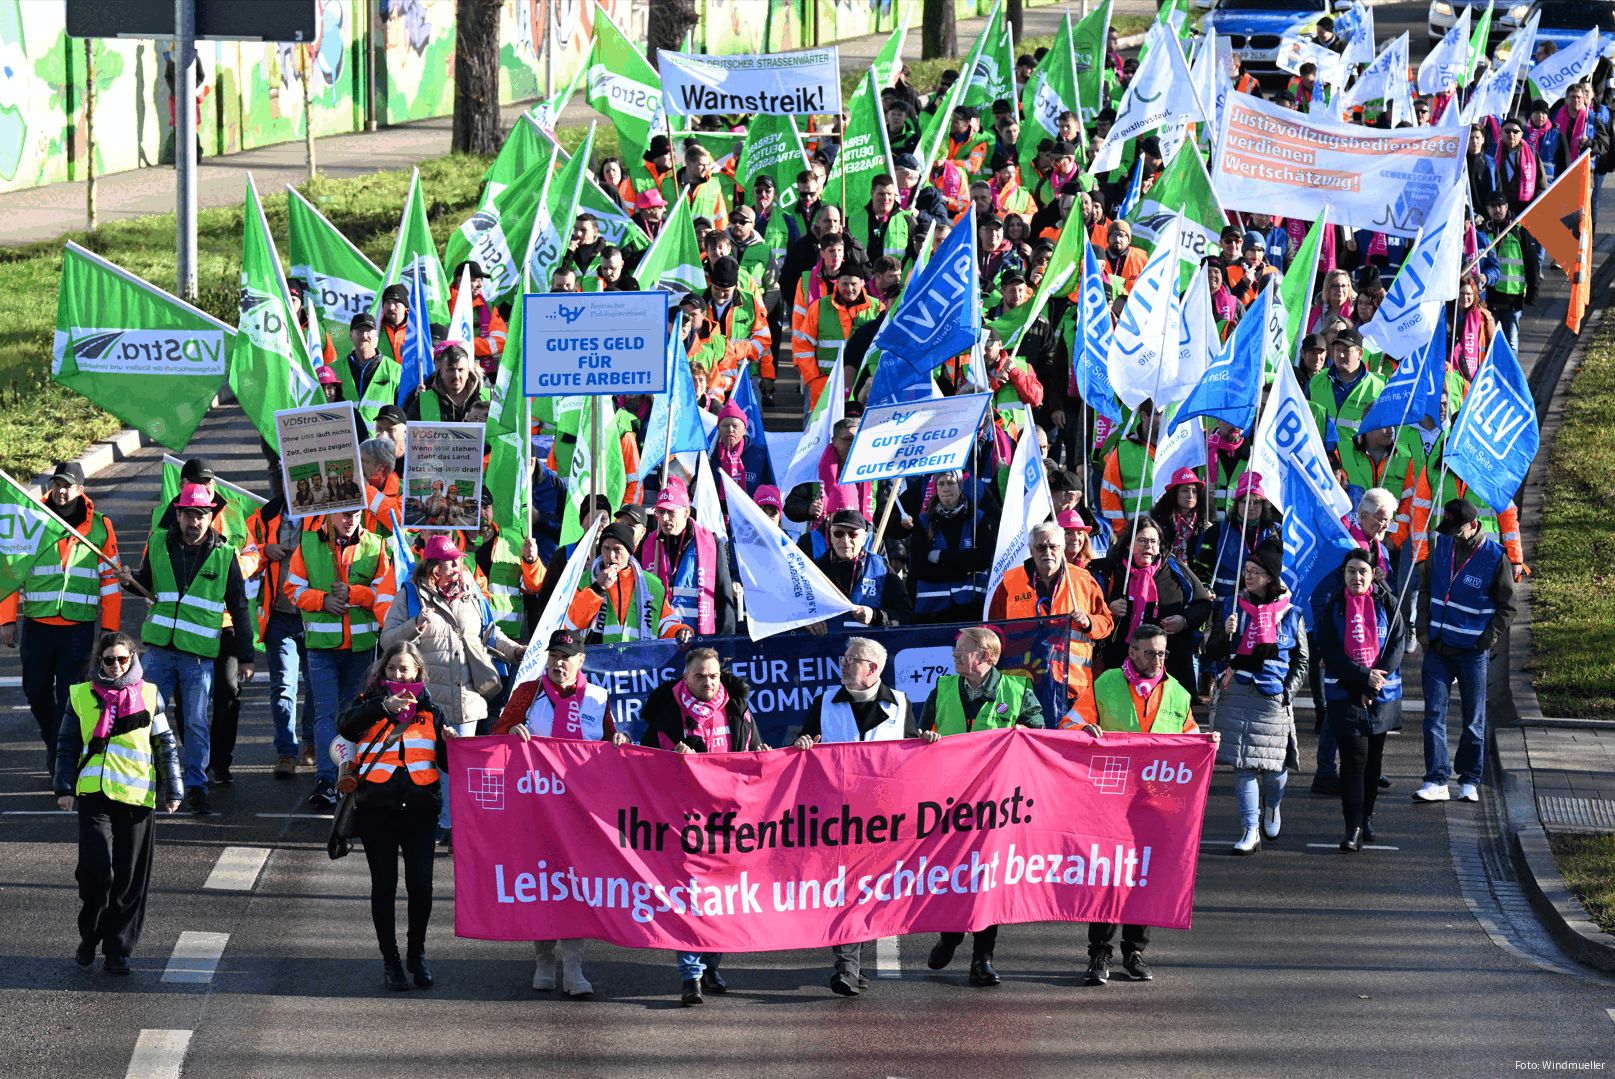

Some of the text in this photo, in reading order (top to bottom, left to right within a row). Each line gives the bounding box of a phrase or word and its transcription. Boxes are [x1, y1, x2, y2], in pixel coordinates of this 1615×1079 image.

[707, 59, 753, 69] DEUTSCHER
[757, 53, 829, 69] STRASSENWÄRTER
[681, 85, 825, 113] Warnstreik!
[1232, 106, 1457, 152] Justizvollzugsbedienstete
[1229, 132, 1314, 164] verdienen
[1224, 153, 1359, 190] Wertschätzung!
[546, 336, 645, 352] GUTES GELD
[578, 352, 612, 369] FÜR
[538, 370, 651, 387] GUTE ARBEIT!
[283, 416, 320, 427] VDStra.
[1095, 419, 1107, 443] dbb
[328, 442, 352, 450] zeigen!
[872, 427, 958, 448] GUTES GELD
[894, 444, 925, 459] FÜR
[1476, 452, 1494, 471] Seite
[856, 453, 956, 476] GUTE ARBEIT!
[658, 491, 674, 500] dbb
[1464, 576, 1481, 588] BLLV
[1351, 613, 1365, 643] dbb
[732, 655, 785, 686] FÜR
[799, 657, 843, 682] EIN
[567, 700, 581, 733] dbb
[516, 770, 566, 795] dbb
[1142, 760, 1193, 784] dbb
[618, 786, 1035, 855] Ihr öffentlicher Dienst:
[495, 844, 1152, 923] Leistungsstark und schlecht bezahlt!
